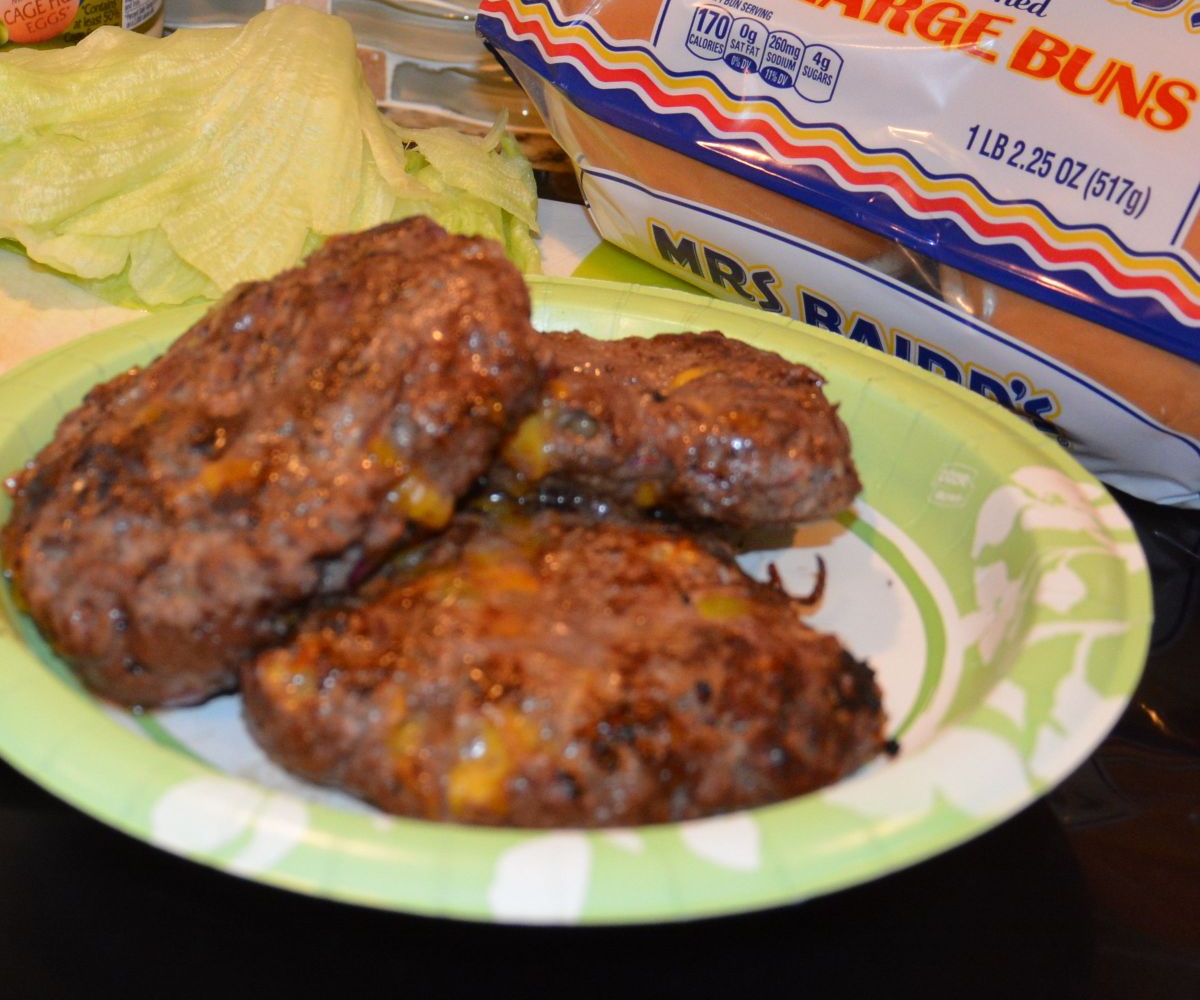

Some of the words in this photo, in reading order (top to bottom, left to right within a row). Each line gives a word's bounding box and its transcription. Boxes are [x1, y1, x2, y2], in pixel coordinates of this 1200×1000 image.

[3, 0, 47, 26] CAGE
[741, 2, 774, 21] SERVING
[696, 8, 730, 40] 170
[739, 23, 758, 45] 0g
[688, 33, 725, 55] CALORIES
[730, 38, 745, 52] SAT
[746, 43, 761, 57] FAT
[769, 35, 801, 61] 260mg
[766, 52, 797, 71] SODIUM
[812, 52, 831, 72] 4g
[764, 69, 778, 82] 11%
[778, 74, 789, 86] DV
[802, 66, 833, 86] SUGARS
[1008, 27, 1198, 132] BUNS
[966, 124, 980, 151] 1
[979, 128, 1009, 161] LB
[1006, 140, 1056, 178] 2.25
[1055, 157, 1088, 190] OZ
[1083, 168, 1152, 220] (517g)
[648, 219, 787, 315] MRS
